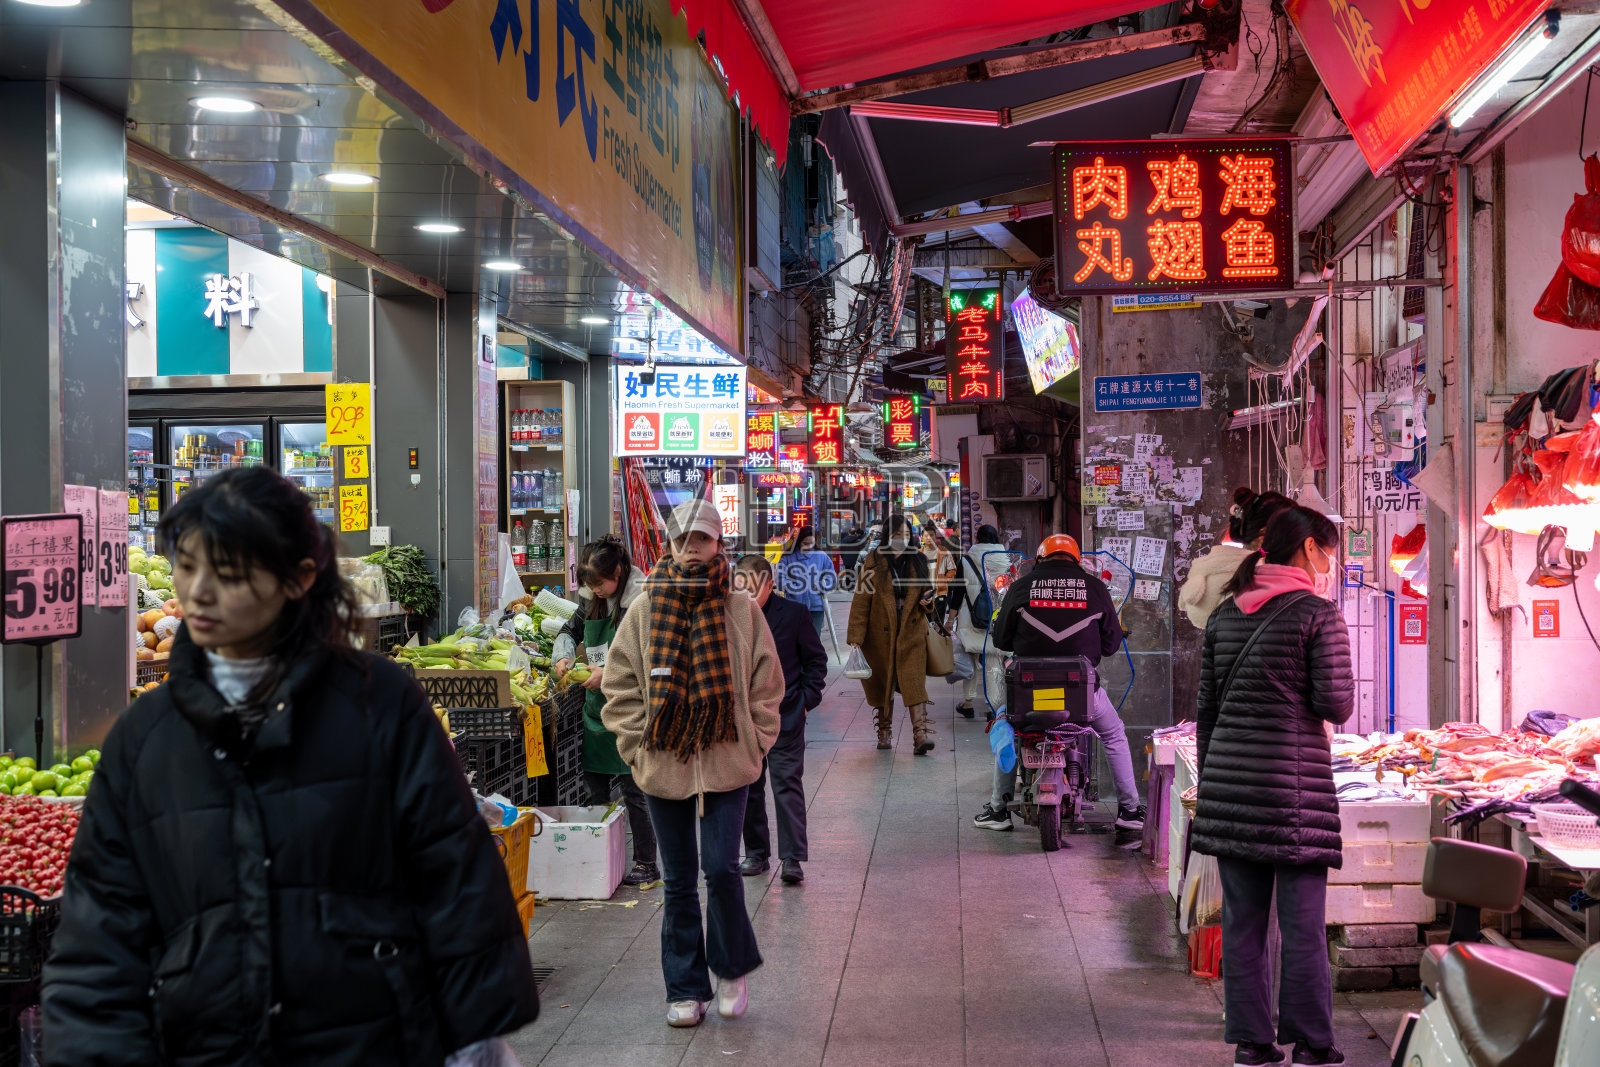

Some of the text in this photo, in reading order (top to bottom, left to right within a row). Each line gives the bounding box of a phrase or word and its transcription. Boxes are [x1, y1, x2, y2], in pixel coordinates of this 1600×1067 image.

[603, 104, 682, 240] Fresh Supermarket
[957, 307, 991, 398] 老马牛羊肉
[624, 372, 740, 399] 好民生鲜
[1098, 378, 1198, 395] 石牌逢源大街十一巷
[624, 401, 739, 411] Haomin Fresh Supermarket
[811, 406, 841, 417] 上门
[1099, 399, 1119, 407] SHIPAI
[1122, 396, 1167, 405] FENGYUANDAJIE
[891, 399, 913, 443] 彩票
[812, 419, 839, 461] 开锁
[351, 457, 360, 474] 3
[1364, 471, 1420, 491] 鸡胸
[1365, 492, 1421, 512] 10元/斤
[719, 495, 742, 535] 开锁
[26, 536, 75, 554] 千禧果
[10, 557, 74, 568] 今天特价
[100, 541, 127, 587] 3.98
[5, 567, 76, 619] 5.98
[1030, 588, 1088, 600] 用顺丰同城
[54, 607, 75, 622] 元/斤
